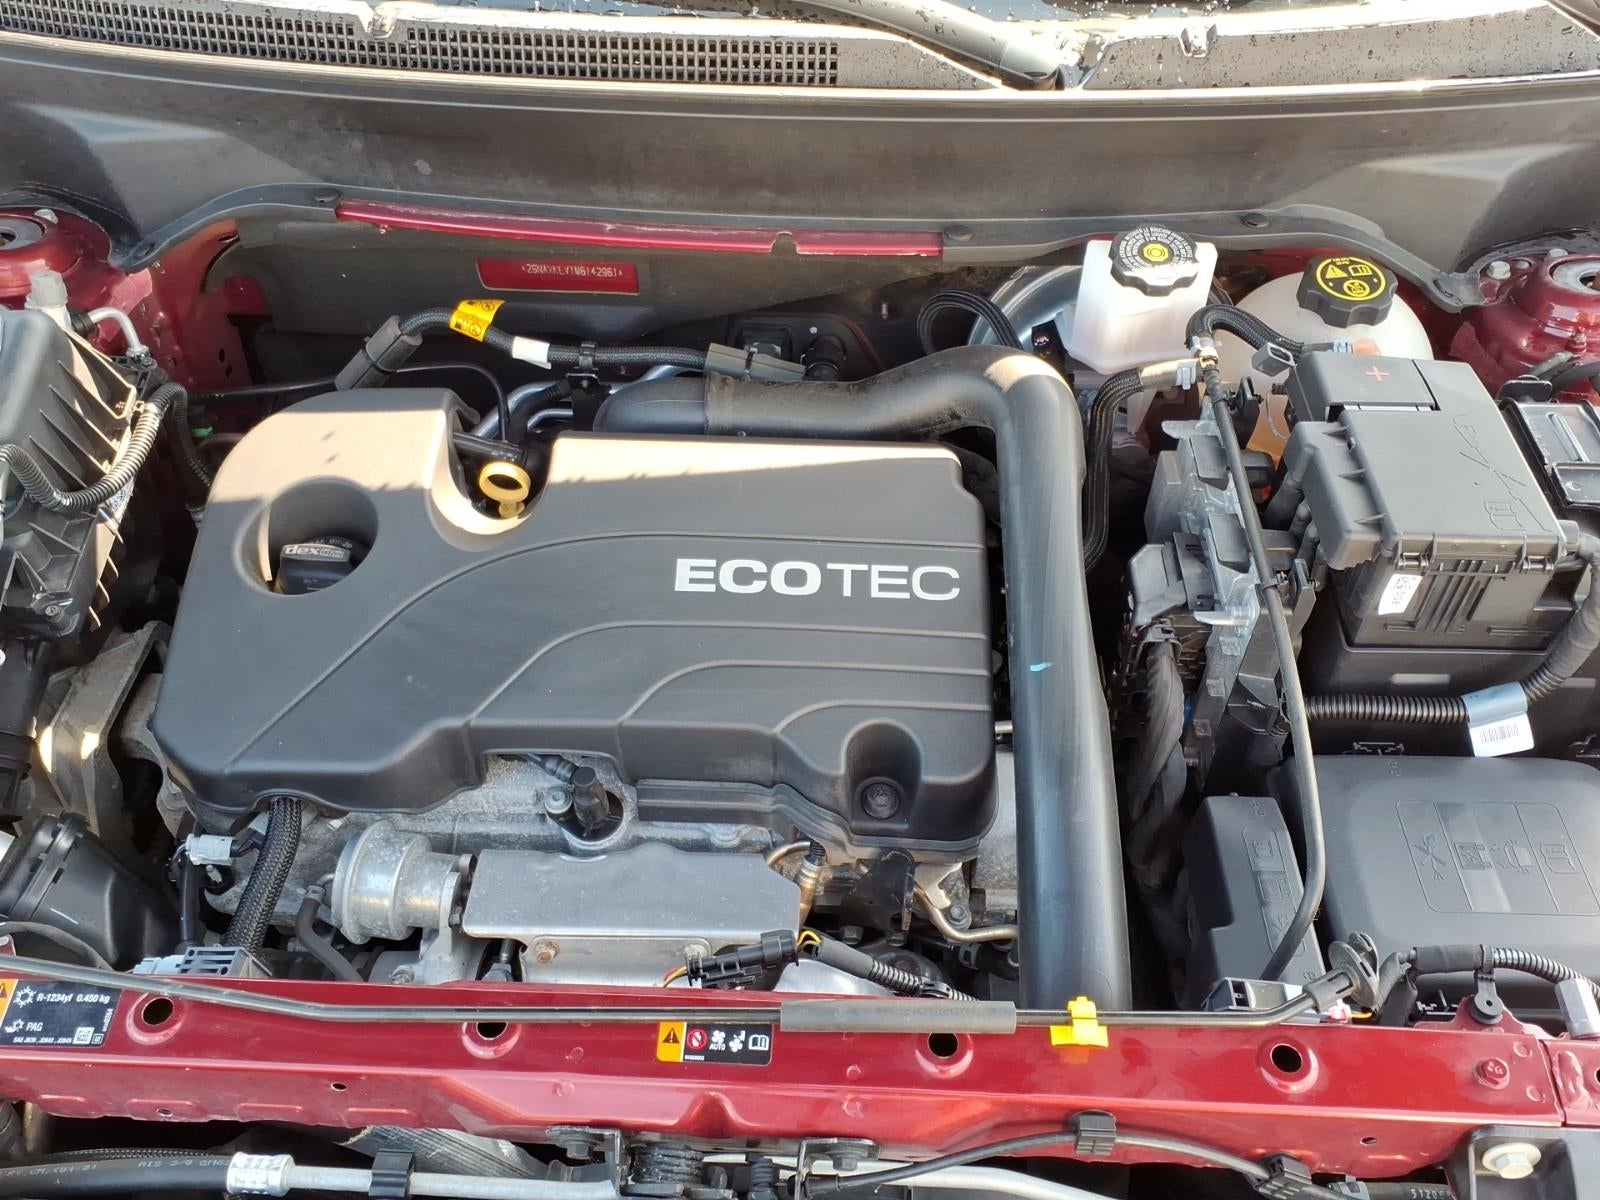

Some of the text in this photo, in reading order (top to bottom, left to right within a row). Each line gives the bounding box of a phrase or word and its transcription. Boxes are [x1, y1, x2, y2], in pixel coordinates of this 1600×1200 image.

[674, 558, 961, 601] ECOTEC
[99, 994, 110, 1004] kg
[26, 1022, 43, 1032] PAG
[709, 1043, 726, 1052] AUTO
